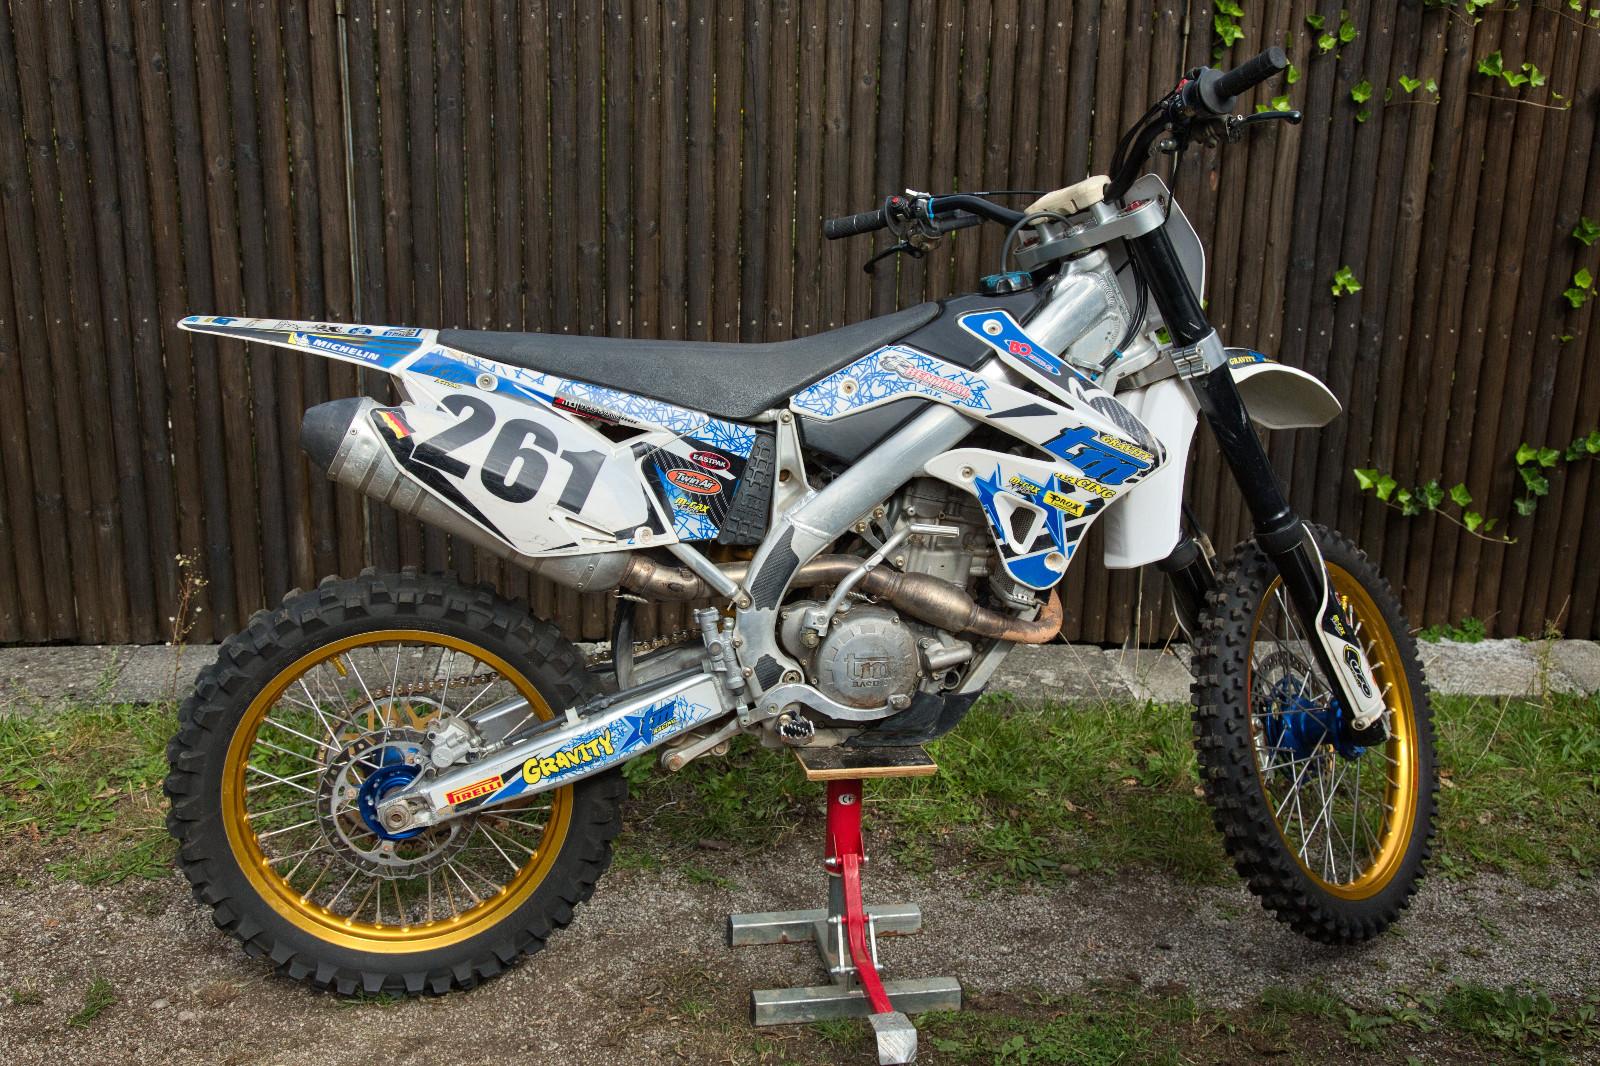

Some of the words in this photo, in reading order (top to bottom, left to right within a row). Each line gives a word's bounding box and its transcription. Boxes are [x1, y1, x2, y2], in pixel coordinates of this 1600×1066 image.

[312, 338, 380, 361] MICHELIN
[1229, 355, 1256, 365] GRAVITY
[411, 394, 607, 514] 261
[1100, 434, 1154, 460] GRAVITY
[692, 453, 726, 468] EASTPAK
[675, 472, 699, 486] Twin
[700, 480, 716, 489] Air
[522, 727, 615, 785] GRAVITY
[446, 775, 503, 805] PIRELLI
